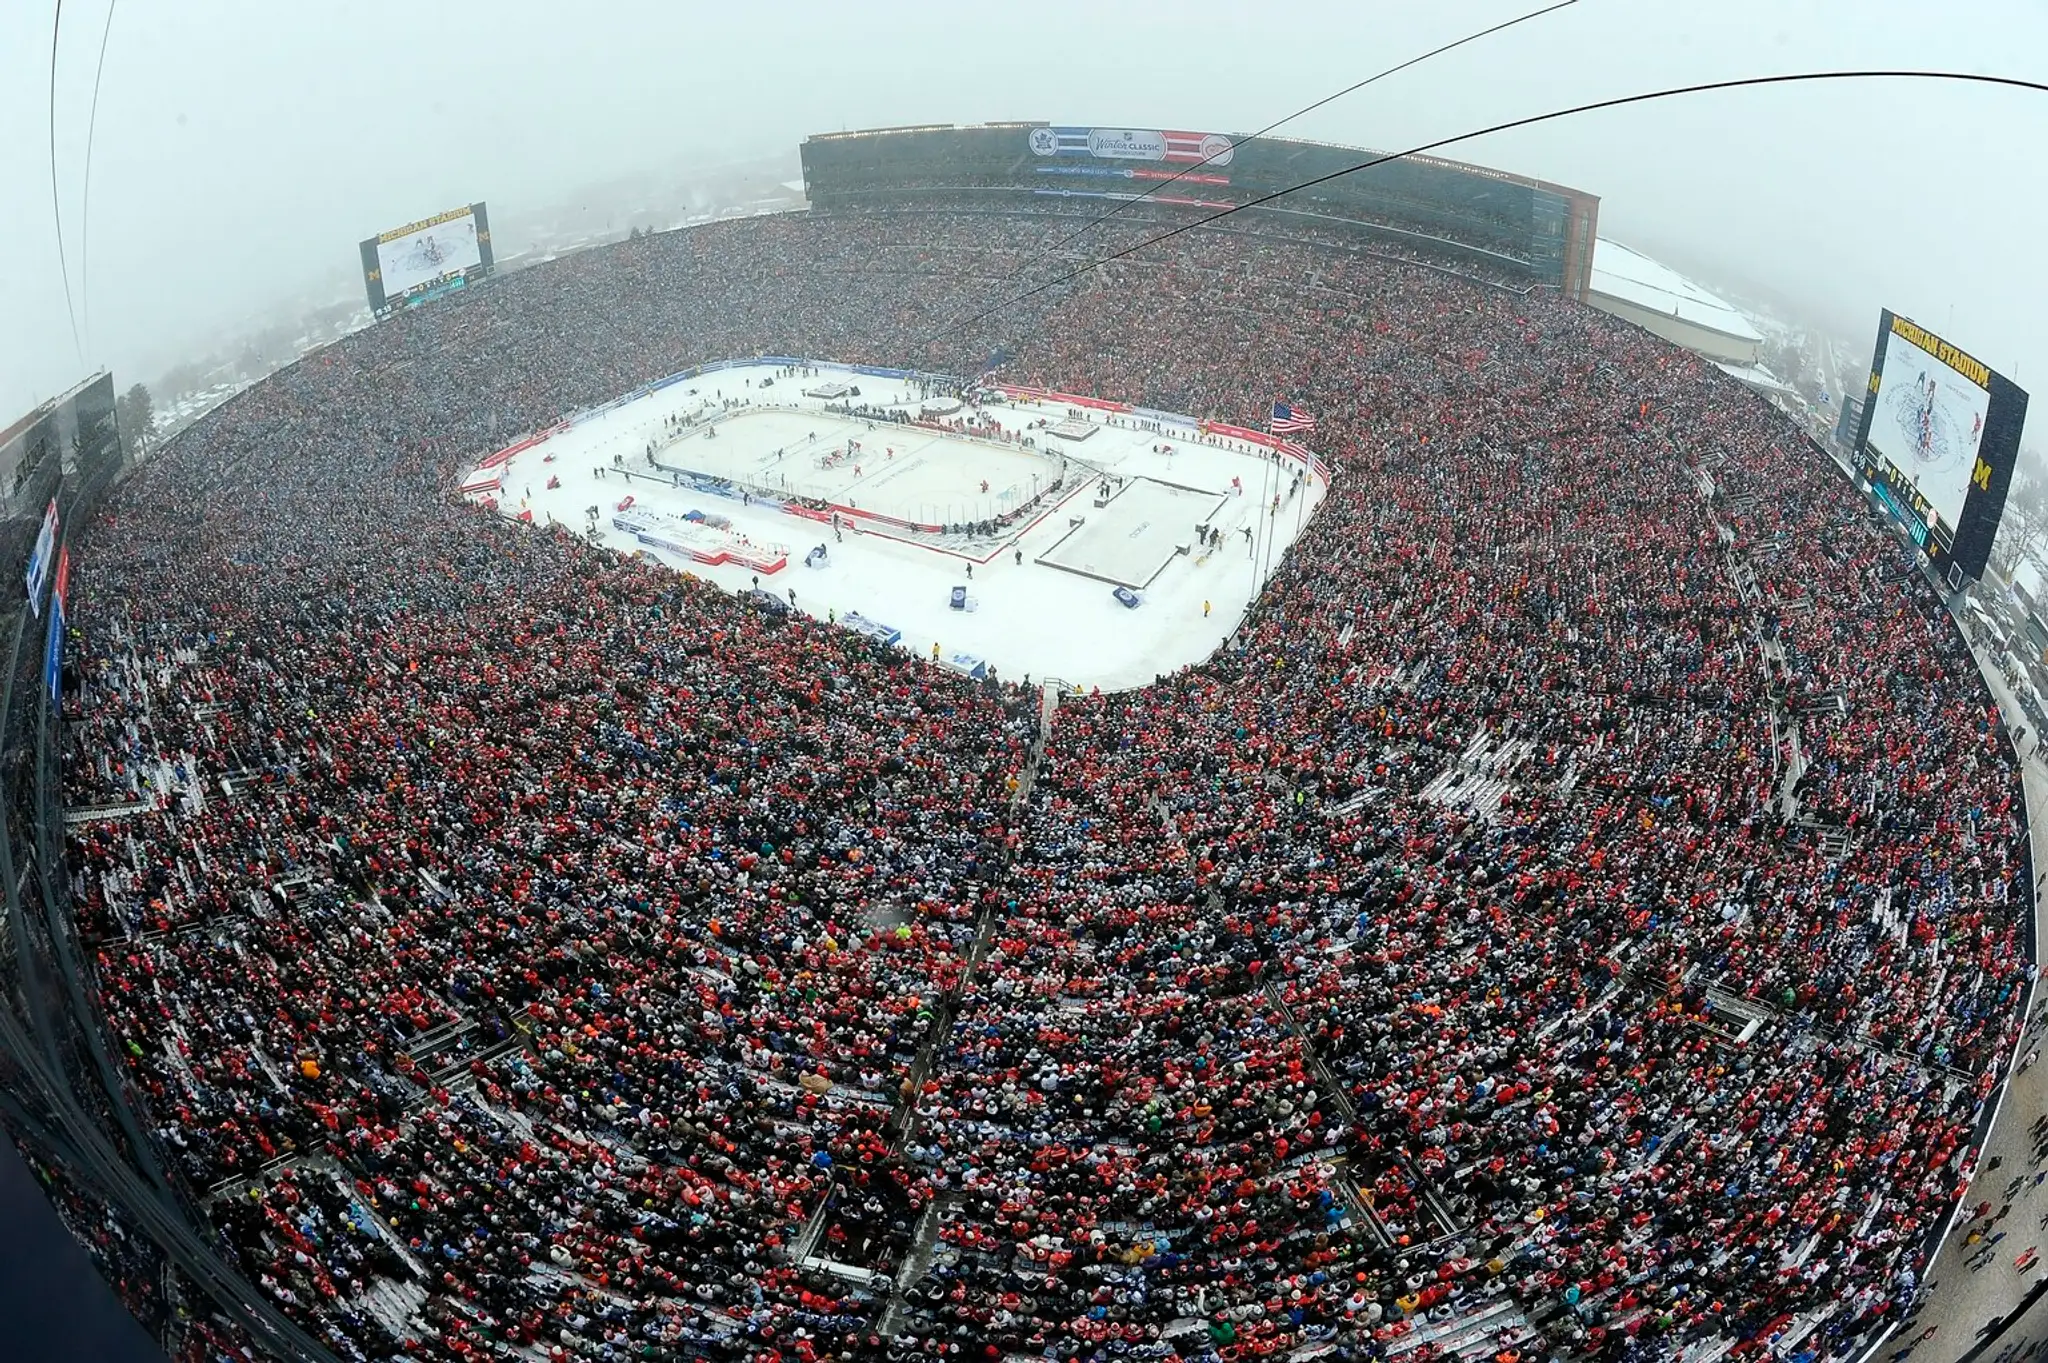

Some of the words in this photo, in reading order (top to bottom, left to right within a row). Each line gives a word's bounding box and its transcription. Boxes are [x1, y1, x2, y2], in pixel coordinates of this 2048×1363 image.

[1096, 136, 1128, 150] Winter
[1128, 142, 1160, 151] CLASSIC
[380, 220, 428, 243] MICHIGAN
[428, 206, 471, 227] STADIUM
[1891, 316, 1939, 355] MICHIGAN
[1938, 340, 1991, 388] STADIUM
[1869, 371, 1880, 393] M
[1973, 457, 1992, 491] M
